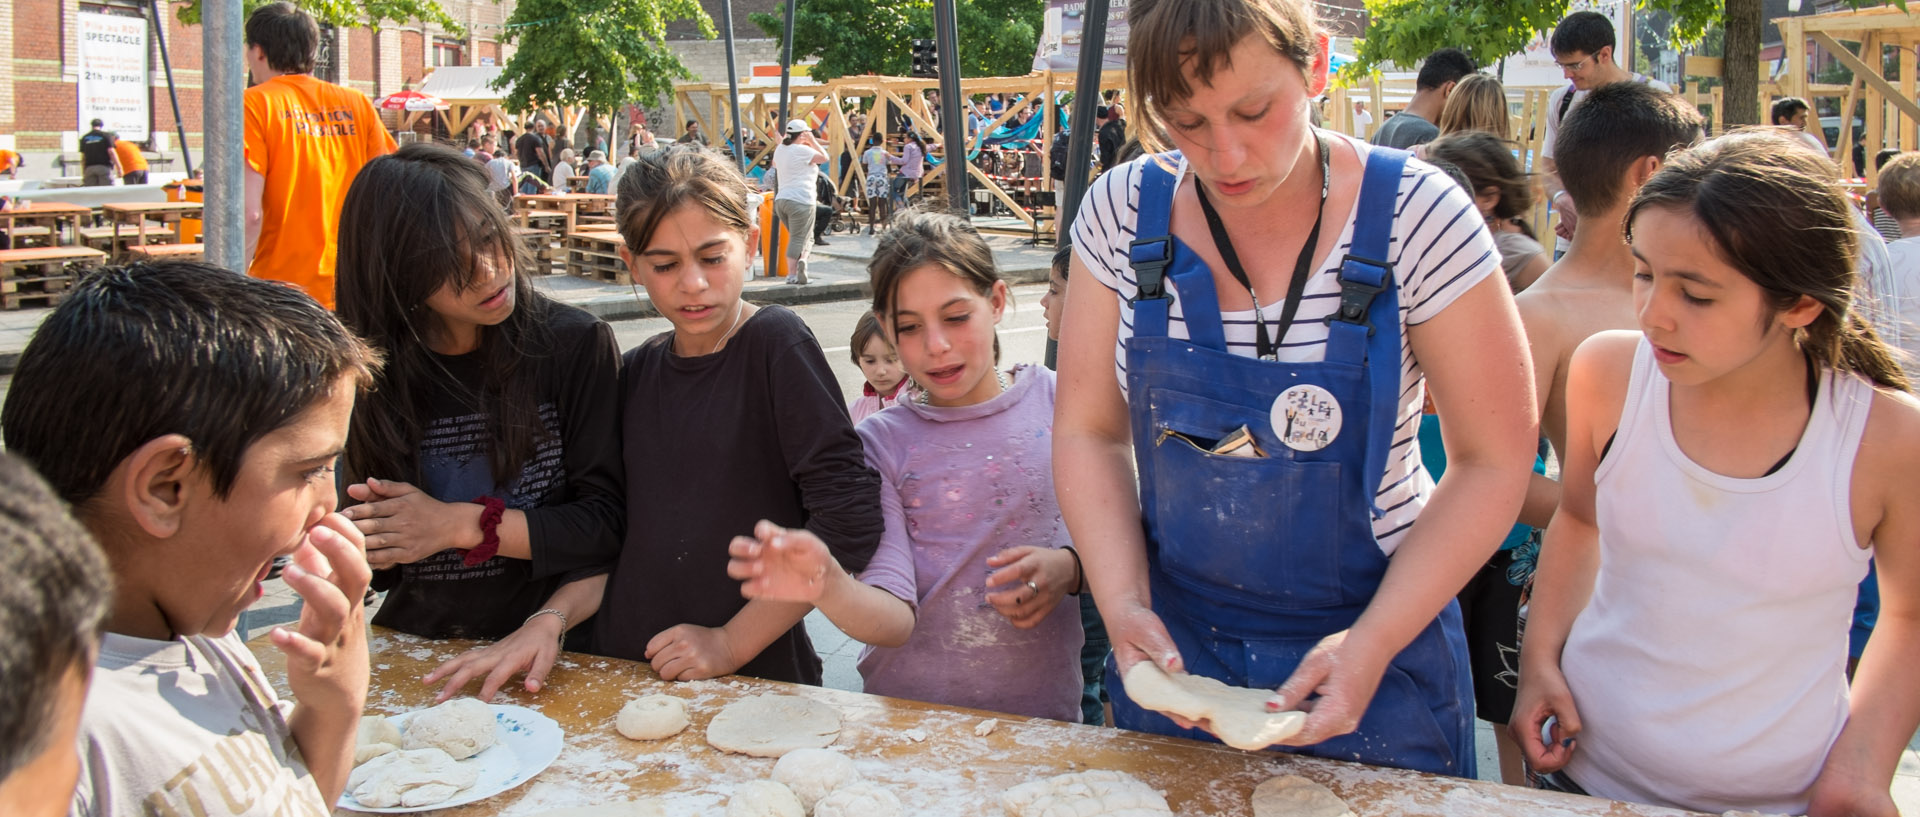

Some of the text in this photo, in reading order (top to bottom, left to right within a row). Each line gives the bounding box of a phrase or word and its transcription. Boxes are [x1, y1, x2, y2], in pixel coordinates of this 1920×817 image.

[86, 32, 141, 46] SPECTACLE
[85, 71, 103, 80] 21h
[110, 74, 141, 84] gratuit
